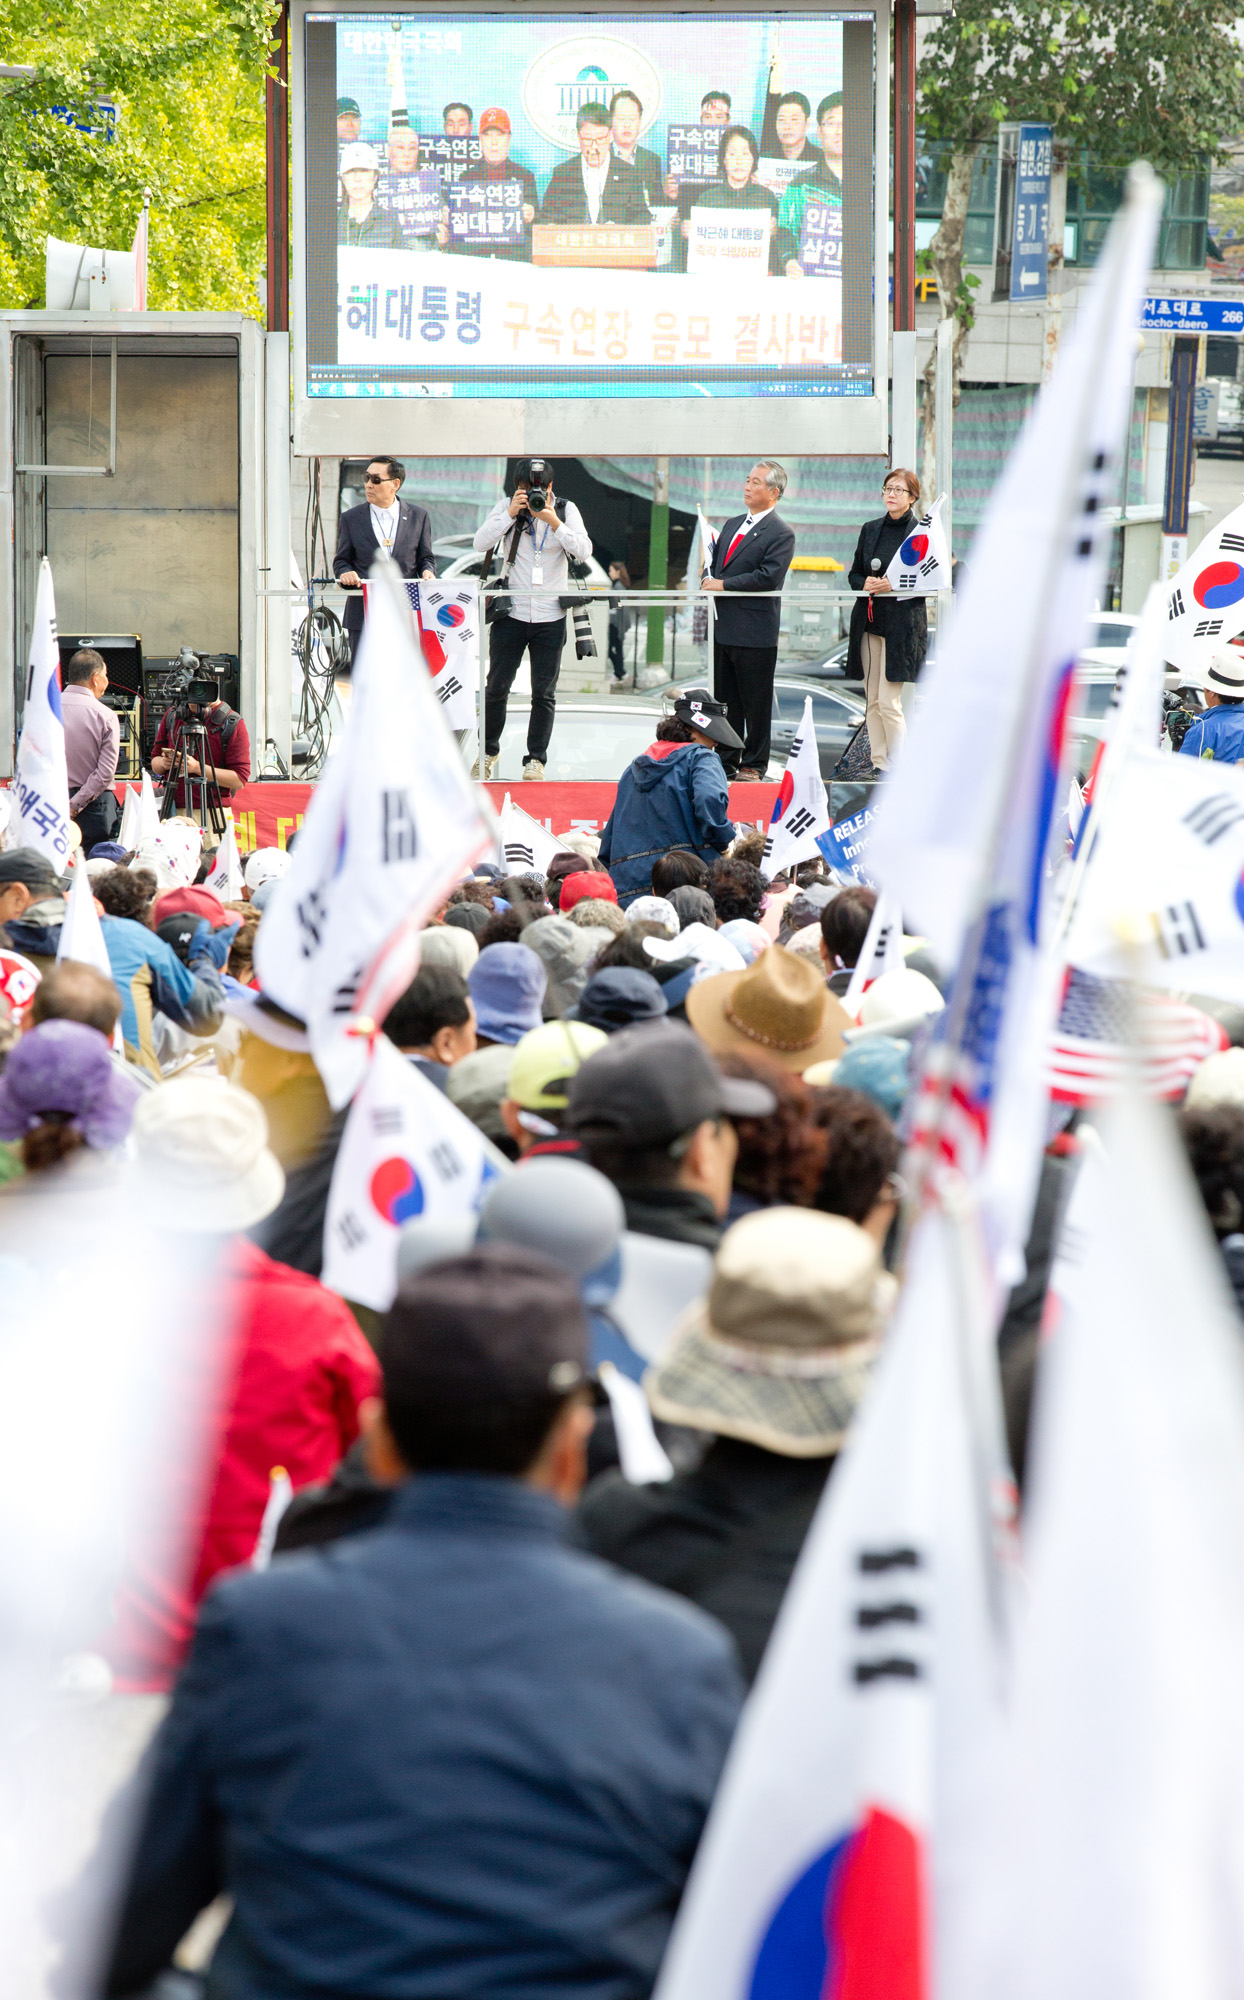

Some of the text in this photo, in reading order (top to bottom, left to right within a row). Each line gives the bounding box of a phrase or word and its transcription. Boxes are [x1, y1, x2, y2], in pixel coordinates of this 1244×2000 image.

[418, 138, 483, 160] 구속연장
[669, 128, 725, 150] 구속연
[669, 153, 718, 176] 절대불
[450, 184, 523, 208] 구속연장
[451, 211, 523, 234] 절대불가
[697, 226, 764, 241] 박근혜 대통령
[338, 283, 482, 345] 혜대통령
[503, 301, 632, 361] 구속연장
[651, 311, 712, 363] 음모
[1142, 299, 1244, 324] 서초대로 266
[1136, 317, 1209, 330] Seocho-daero
